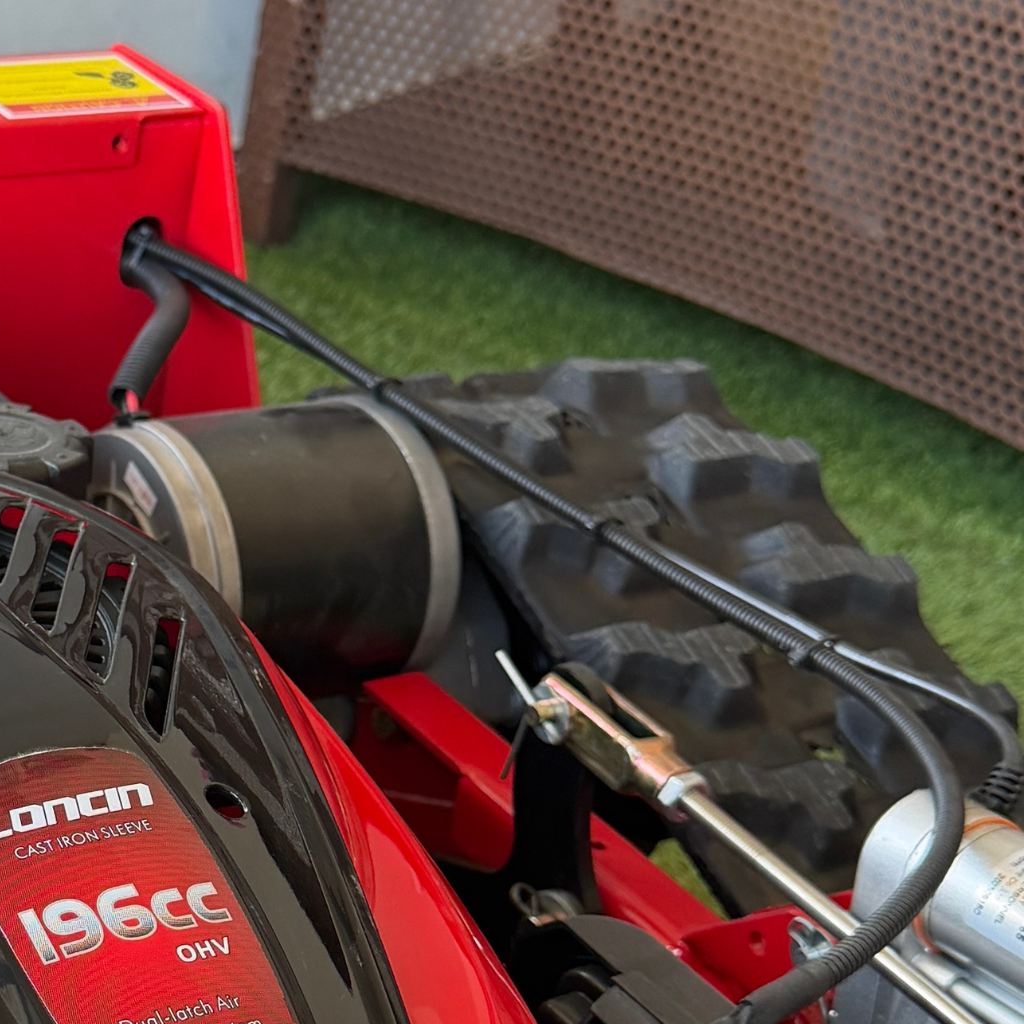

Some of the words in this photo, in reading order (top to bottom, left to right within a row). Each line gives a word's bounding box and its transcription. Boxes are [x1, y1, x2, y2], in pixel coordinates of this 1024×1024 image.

[14, 839, 54, 860] CAST
[57, 829, 100, 850] IRON
[100, 819, 153, 839] SLEEVE
[17, 881, 233, 966] 196cc
[176, 936, 231, 964] OHV
[216, 994, 241, 1012] Air
